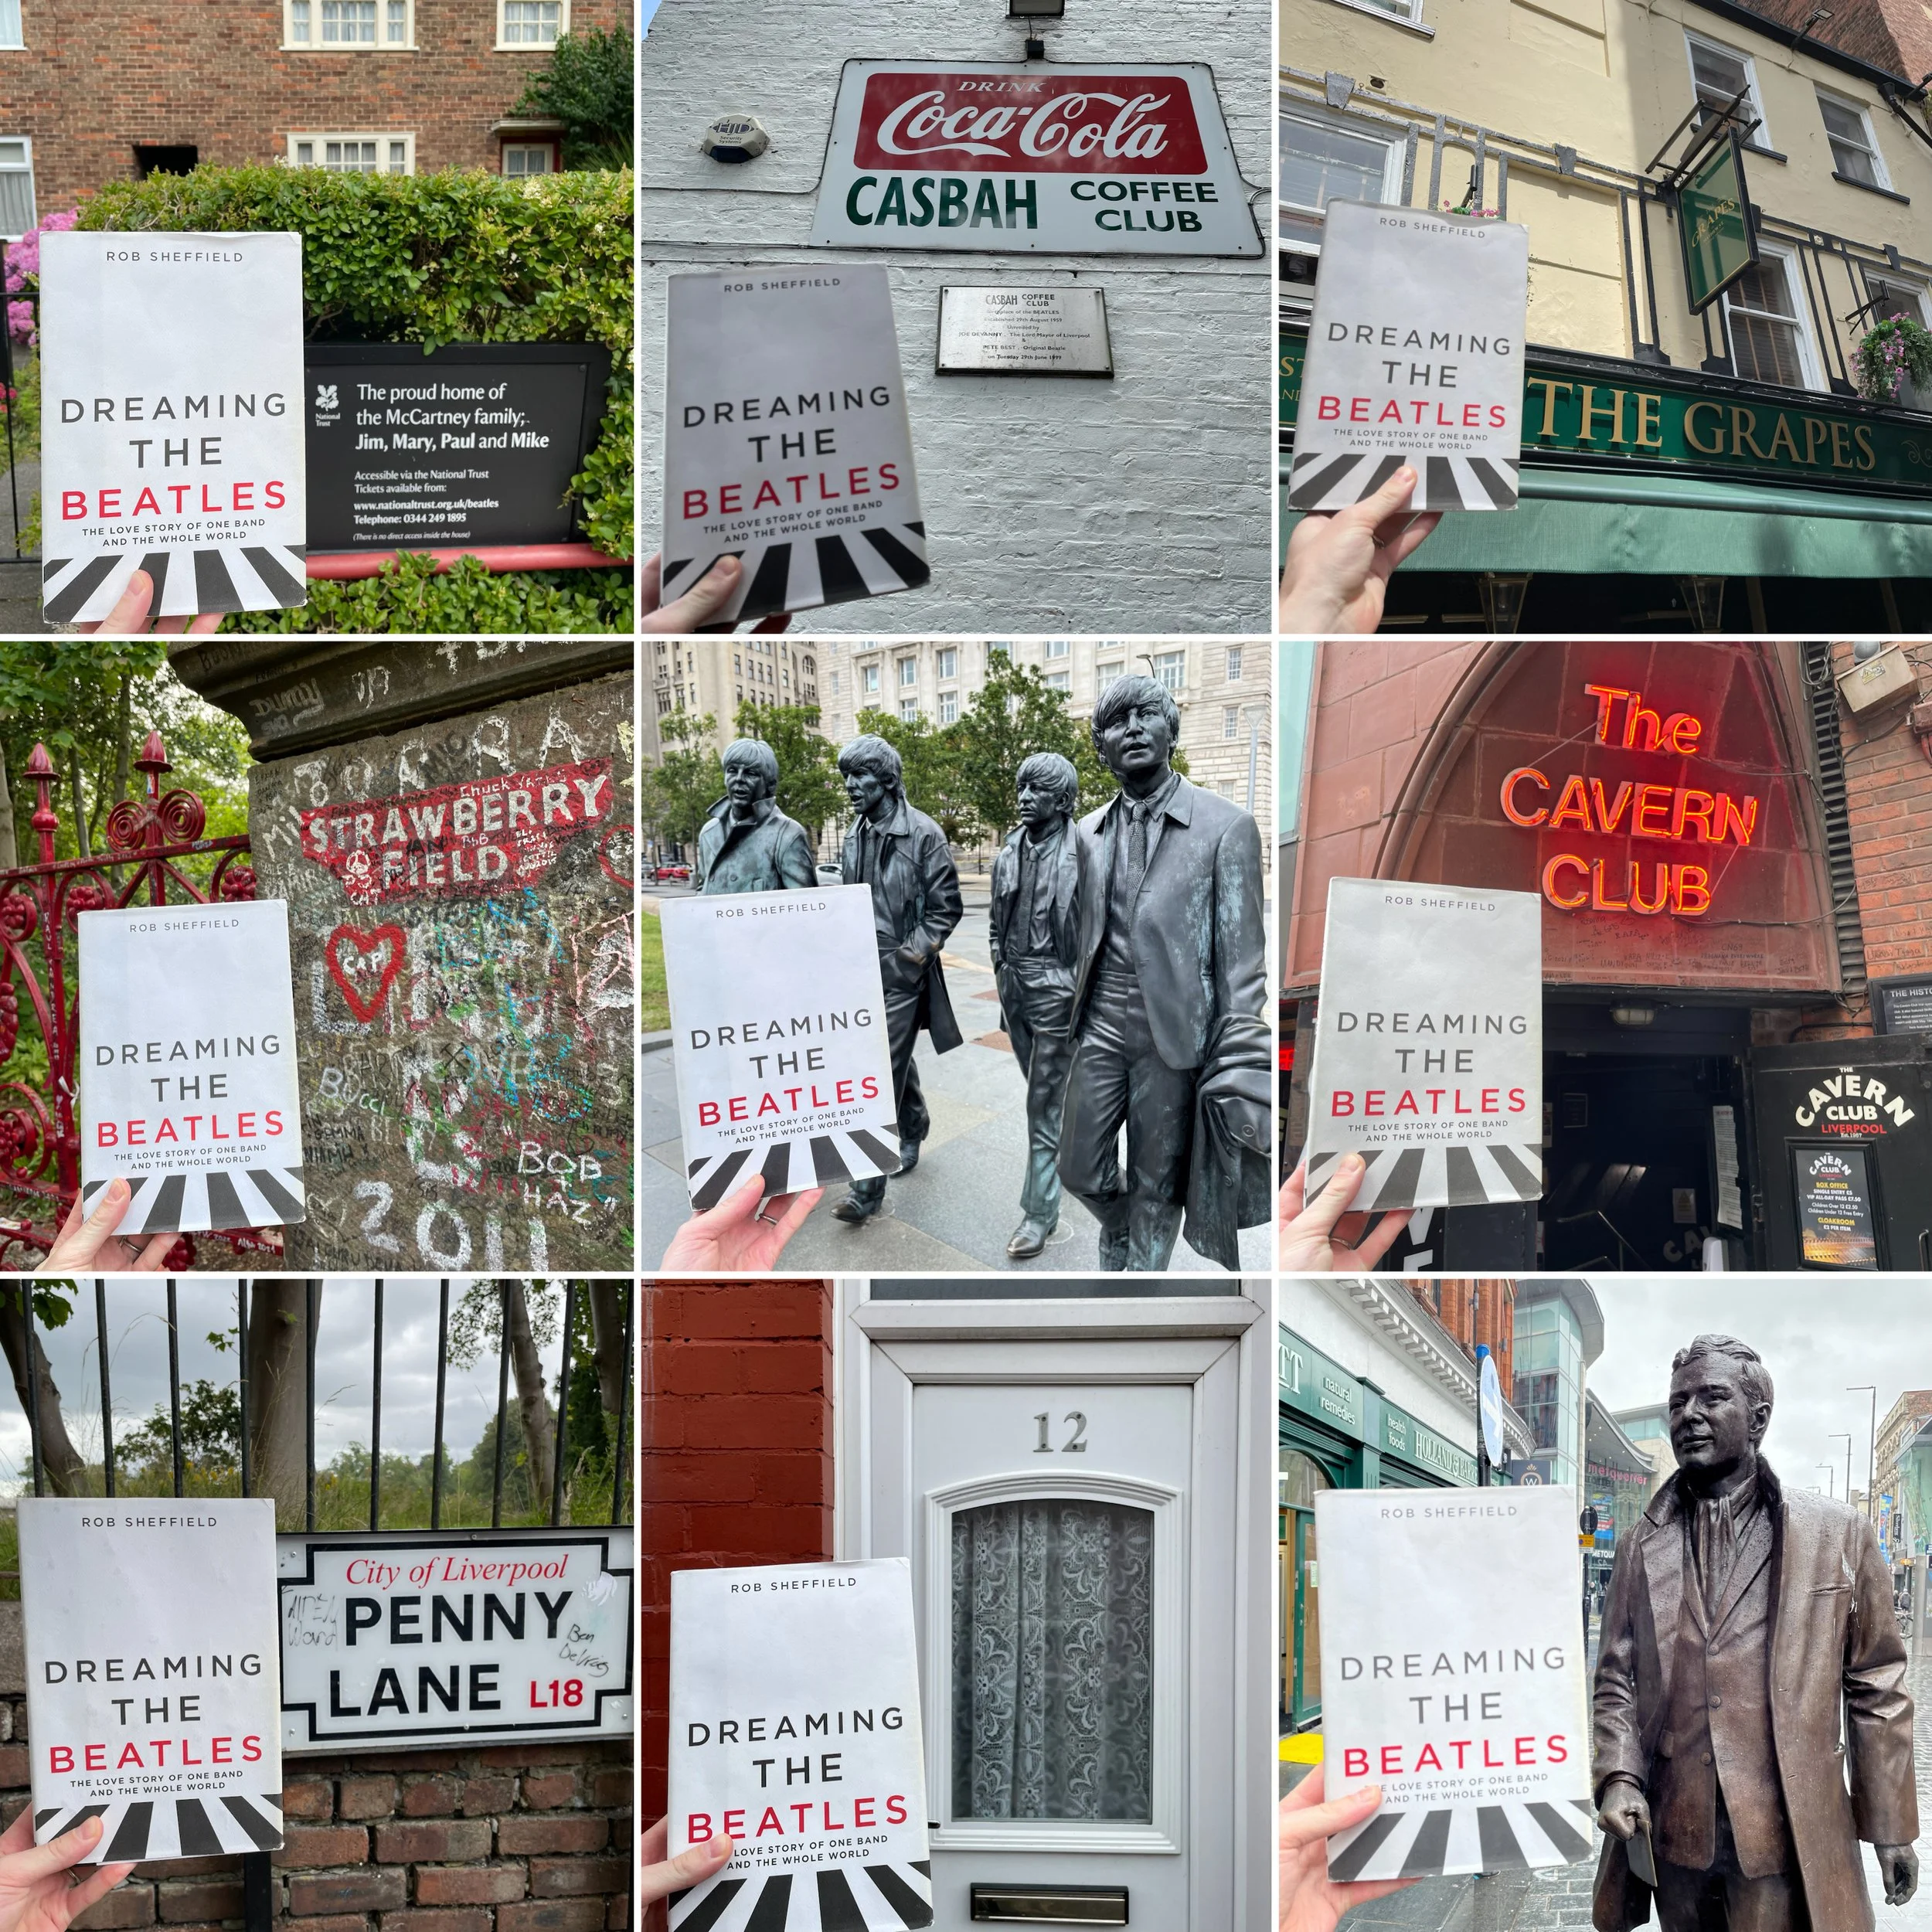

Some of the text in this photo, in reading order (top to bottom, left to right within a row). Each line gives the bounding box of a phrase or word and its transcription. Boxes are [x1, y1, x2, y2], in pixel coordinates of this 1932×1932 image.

[957, 80, 1046, 94] DRINK
[877, 89, 1172, 158] Coca-Cola
[845, 176, 1039, 230] CASBAH
[1070, 180, 1219, 203] COFFEE
[1095, 209, 1202, 233] CLUB
[1380, 218, 1485, 238] ROB SHEFFIELD
[1692, 198, 1734, 247] GRAPES
[107, 252, 242, 261] ROB SHEFFIELD
[985, 294, 1018, 305] CASBAH
[1328, 323, 1509, 355] DREAMING
[1383, 361, 1458, 388] THE
[62, 393, 284, 423] DREAMING
[356, 383, 508, 403] The proud home of
[685, 386, 889, 427] DREAMING
[356, 409, 382, 425] the
[386, 409, 471, 428] McCartney
[1318, 396, 1505, 427] BEATLES
[1527, 377, 1876, 471] THE GRAPES
[130, 437, 221, 468] THE
[355, 432, 549, 452] Jim, Mary, Paul and Mike
[748, 428, 836, 462] THE
[355, 471, 399, 480] Accessible
[414, 471, 428, 479] the
[430, 470, 466, 478] National
[468, 469, 489, 478] Trust
[355, 483, 447, 493] Tickets available from:
[63, 481, 284, 519] BEATLES
[354, 499, 499, 511] www.nationaltrust.org.uk/beatles
[684, 464, 899, 519] BEATLES
[353, 513, 467, 526] Telephone: 0344 249 1895
[1584, 683, 1702, 756] The
[310, 774, 607, 852] STRAWBERRY
[1500, 767, 1757, 846] CAVERN
[383, 846, 508, 889] FIELD
[1542, 853, 1713, 916] CLUB
[1386, 896, 1495, 911] ROB SHEFFIELD
[691, 1009, 871, 1049] DREAMING
[1338, 1012, 1526, 1034] DREAMING
[97, 1036, 279, 1066] DREAMING
[750, 1048, 825, 1078] THE
[1396, 1049, 1473, 1073] THE
[151, 1074, 227, 1102] THE
[699, 1077, 878, 1126] BEATLES
[1332, 1088, 1525, 1116] BEATLES
[1795, 1075, 1915, 1128] CAVERN
[1826, 1105, 1878, 1121] CLUB
[98, 1111, 283, 1147] BEATLES
[1821, 1124, 1886, 1134] LIVERPOOL
[518, 1141, 602, 1181] BOB
[1809, 1155, 1852, 1175] CAVERN
[354, 1180, 549, 1271] 2011
[1325, 1377, 1352, 1403] natural
[1321, 1397, 1355, 1425] remedies
[1387, 1413, 1406, 1435] health
[1032, 1411, 1088, 1454] 12
[1388, 1434, 1406, 1451] foods
[1414, 1430, 1452, 1470] HOLLAND
[1452, 1454, 1459, 1477] &
[346, 1554, 569, 1590] City of Liverpool
[732, 1578, 855, 1593] ROB SHEFFIELD
[345, 1590, 573, 1646] PENNY
[46, 1655, 260, 1683] DREAMING
[1342, 1648, 1563, 1680] DREAMING
[330, 1664, 583, 1717] LANE L18
[111, 1696, 200, 1725] THE
[1410, 1692, 1502, 1723] THE
[689, 1708, 902, 1747] DREAMING
[50, 1736, 261, 1773] BEATLES
[753, 1753, 842, 1787] THE
[1345, 1736, 1566, 1777] BEATLES
[689, 1795, 906, 1843] BEATLES
